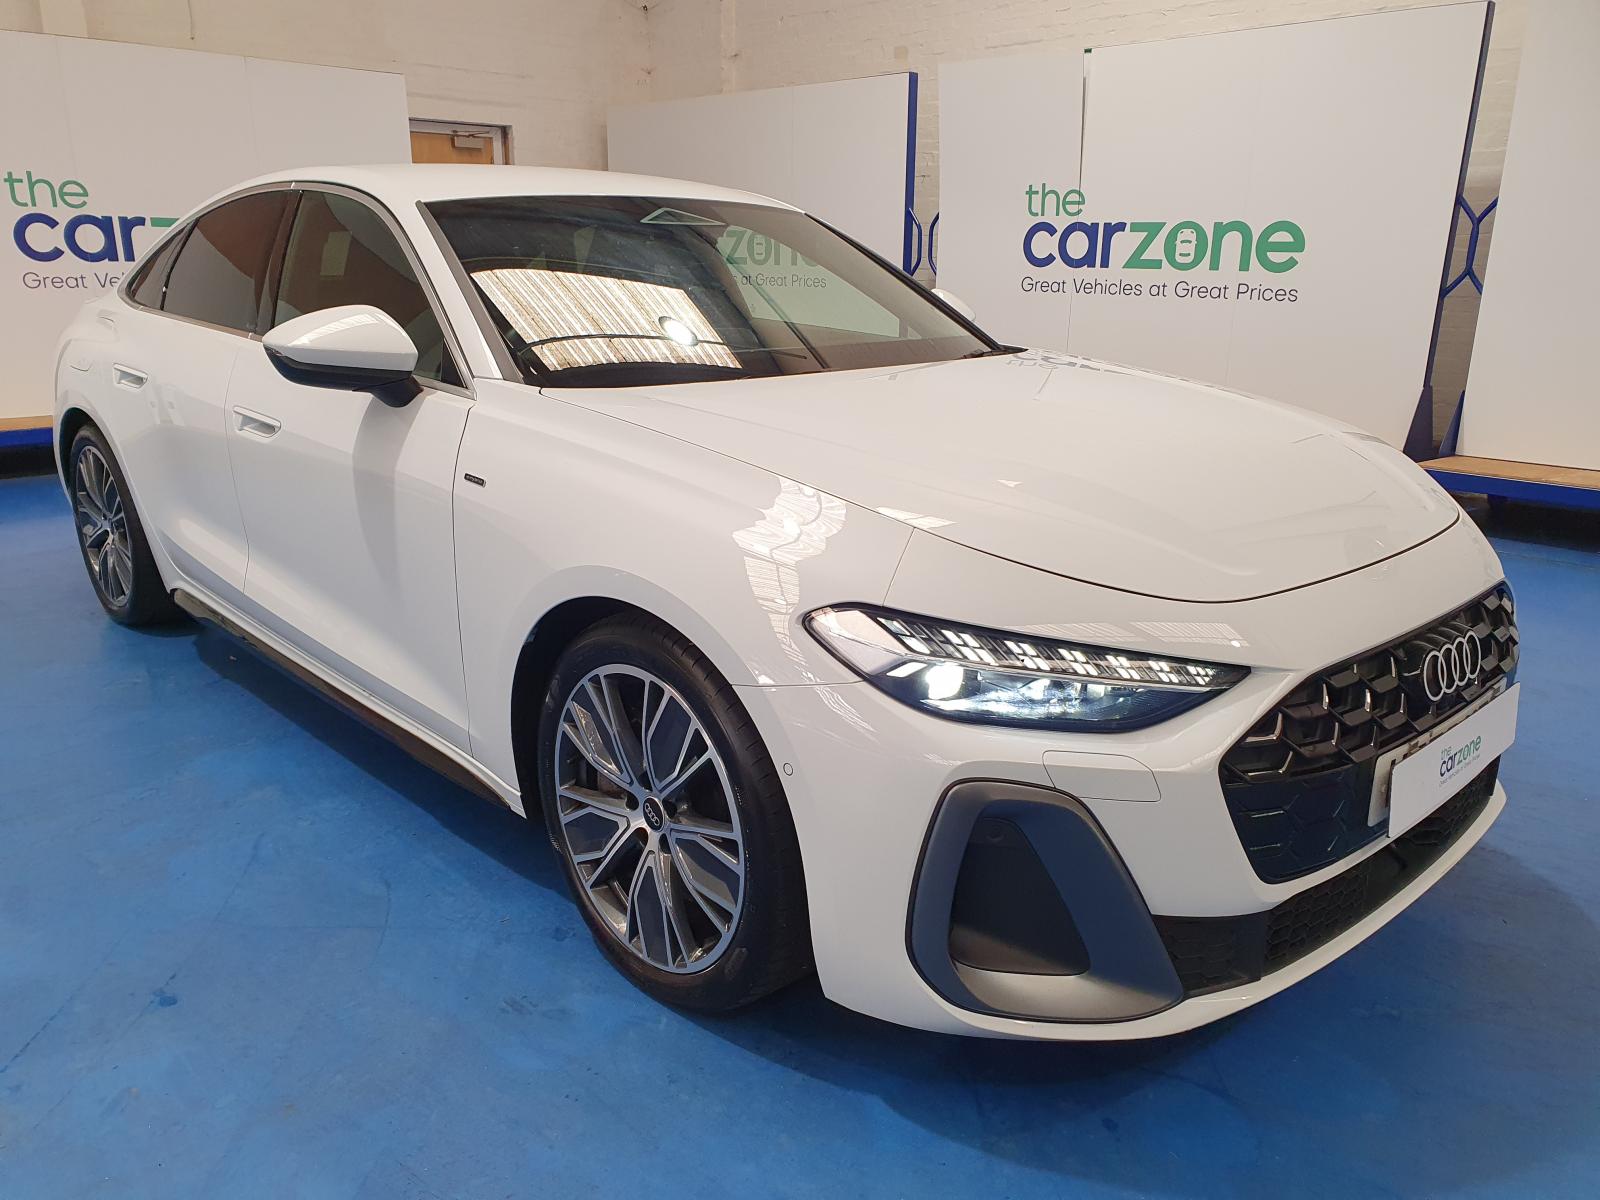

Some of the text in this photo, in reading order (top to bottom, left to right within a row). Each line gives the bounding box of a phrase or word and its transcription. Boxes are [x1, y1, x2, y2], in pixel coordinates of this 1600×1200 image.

[3, 170, 89, 209] the
[1025, 183, 1086, 217] the
[1022, 219, 1306, 274] carzone
[22, 271, 87, 289] Great
[755, 273, 787, 287] Great
[791, 274, 827, 288] Prices
[1021, 276, 1299, 302] Great Vehicles at Great Prices
[1440, 735, 1482, 777] carzone
